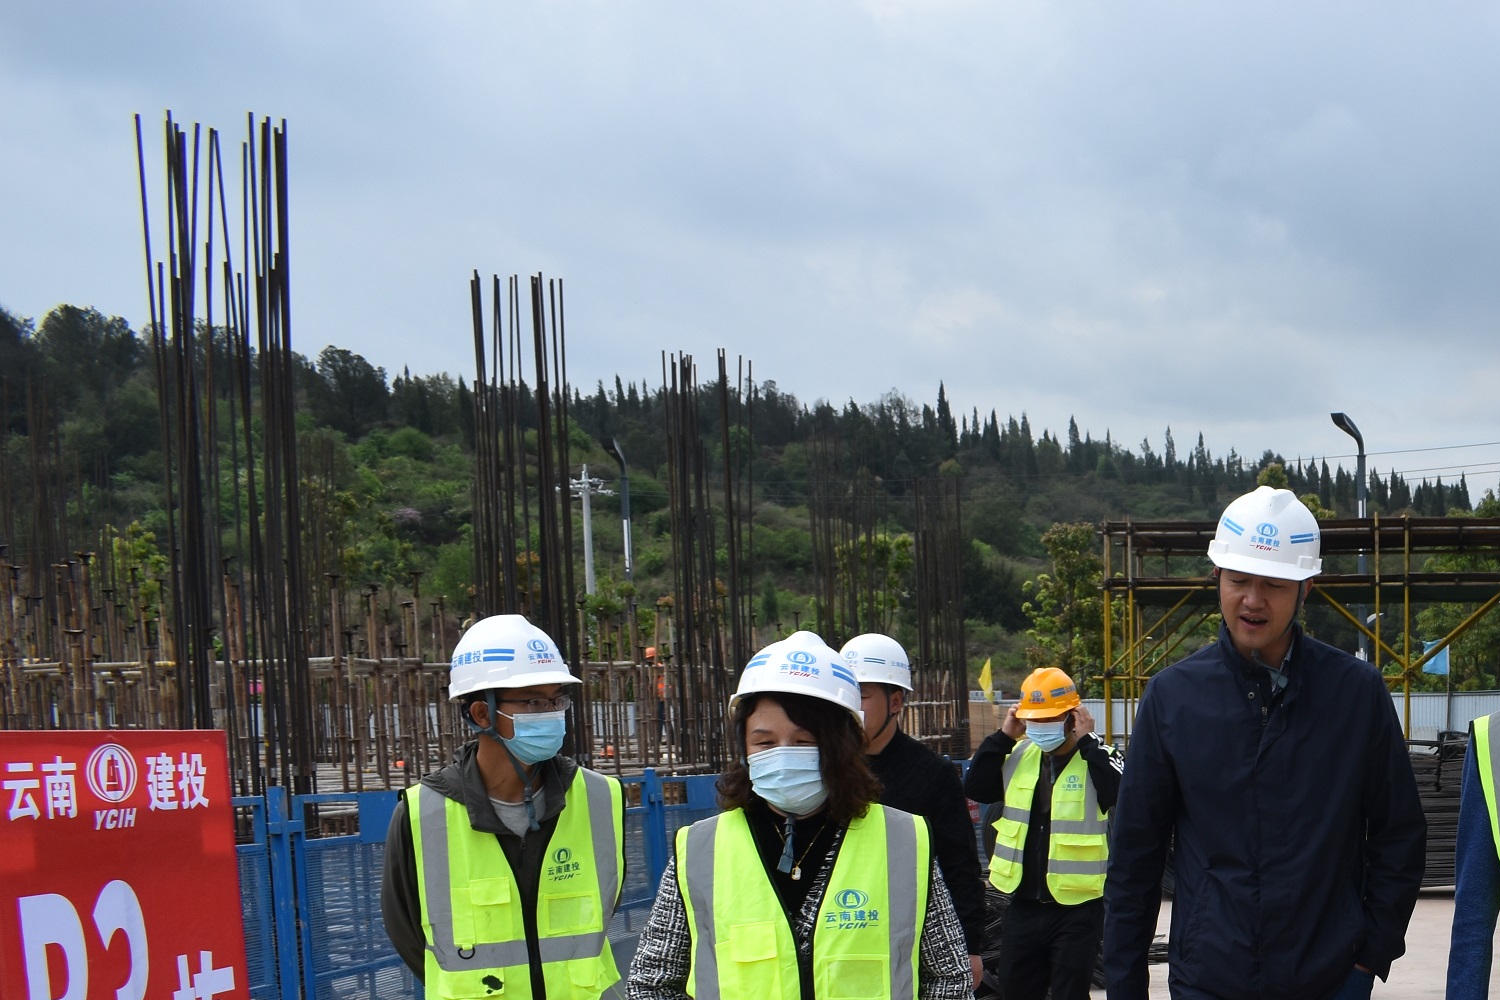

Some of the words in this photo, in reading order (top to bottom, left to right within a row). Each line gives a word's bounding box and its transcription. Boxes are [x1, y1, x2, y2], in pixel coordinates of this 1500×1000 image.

[1251, 536, 1280, 548] 云南建投
[452, 650, 482, 668] 云南建投
[528, 652, 555, 660] 云南建投
[780, 663, 820, 676] 云南建投
[788, 670, 811, 678] YCIH
[3, 755, 78, 822] 云南
[146, 752, 210, 812] 建投
[94, 808, 137, 831] YCIH
[548, 862, 580, 876] 云南建投
[553, 873, 575, 882] YCIH
[825, 910, 879, 922] 云南建投
[838, 922, 868, 930] YCIH
